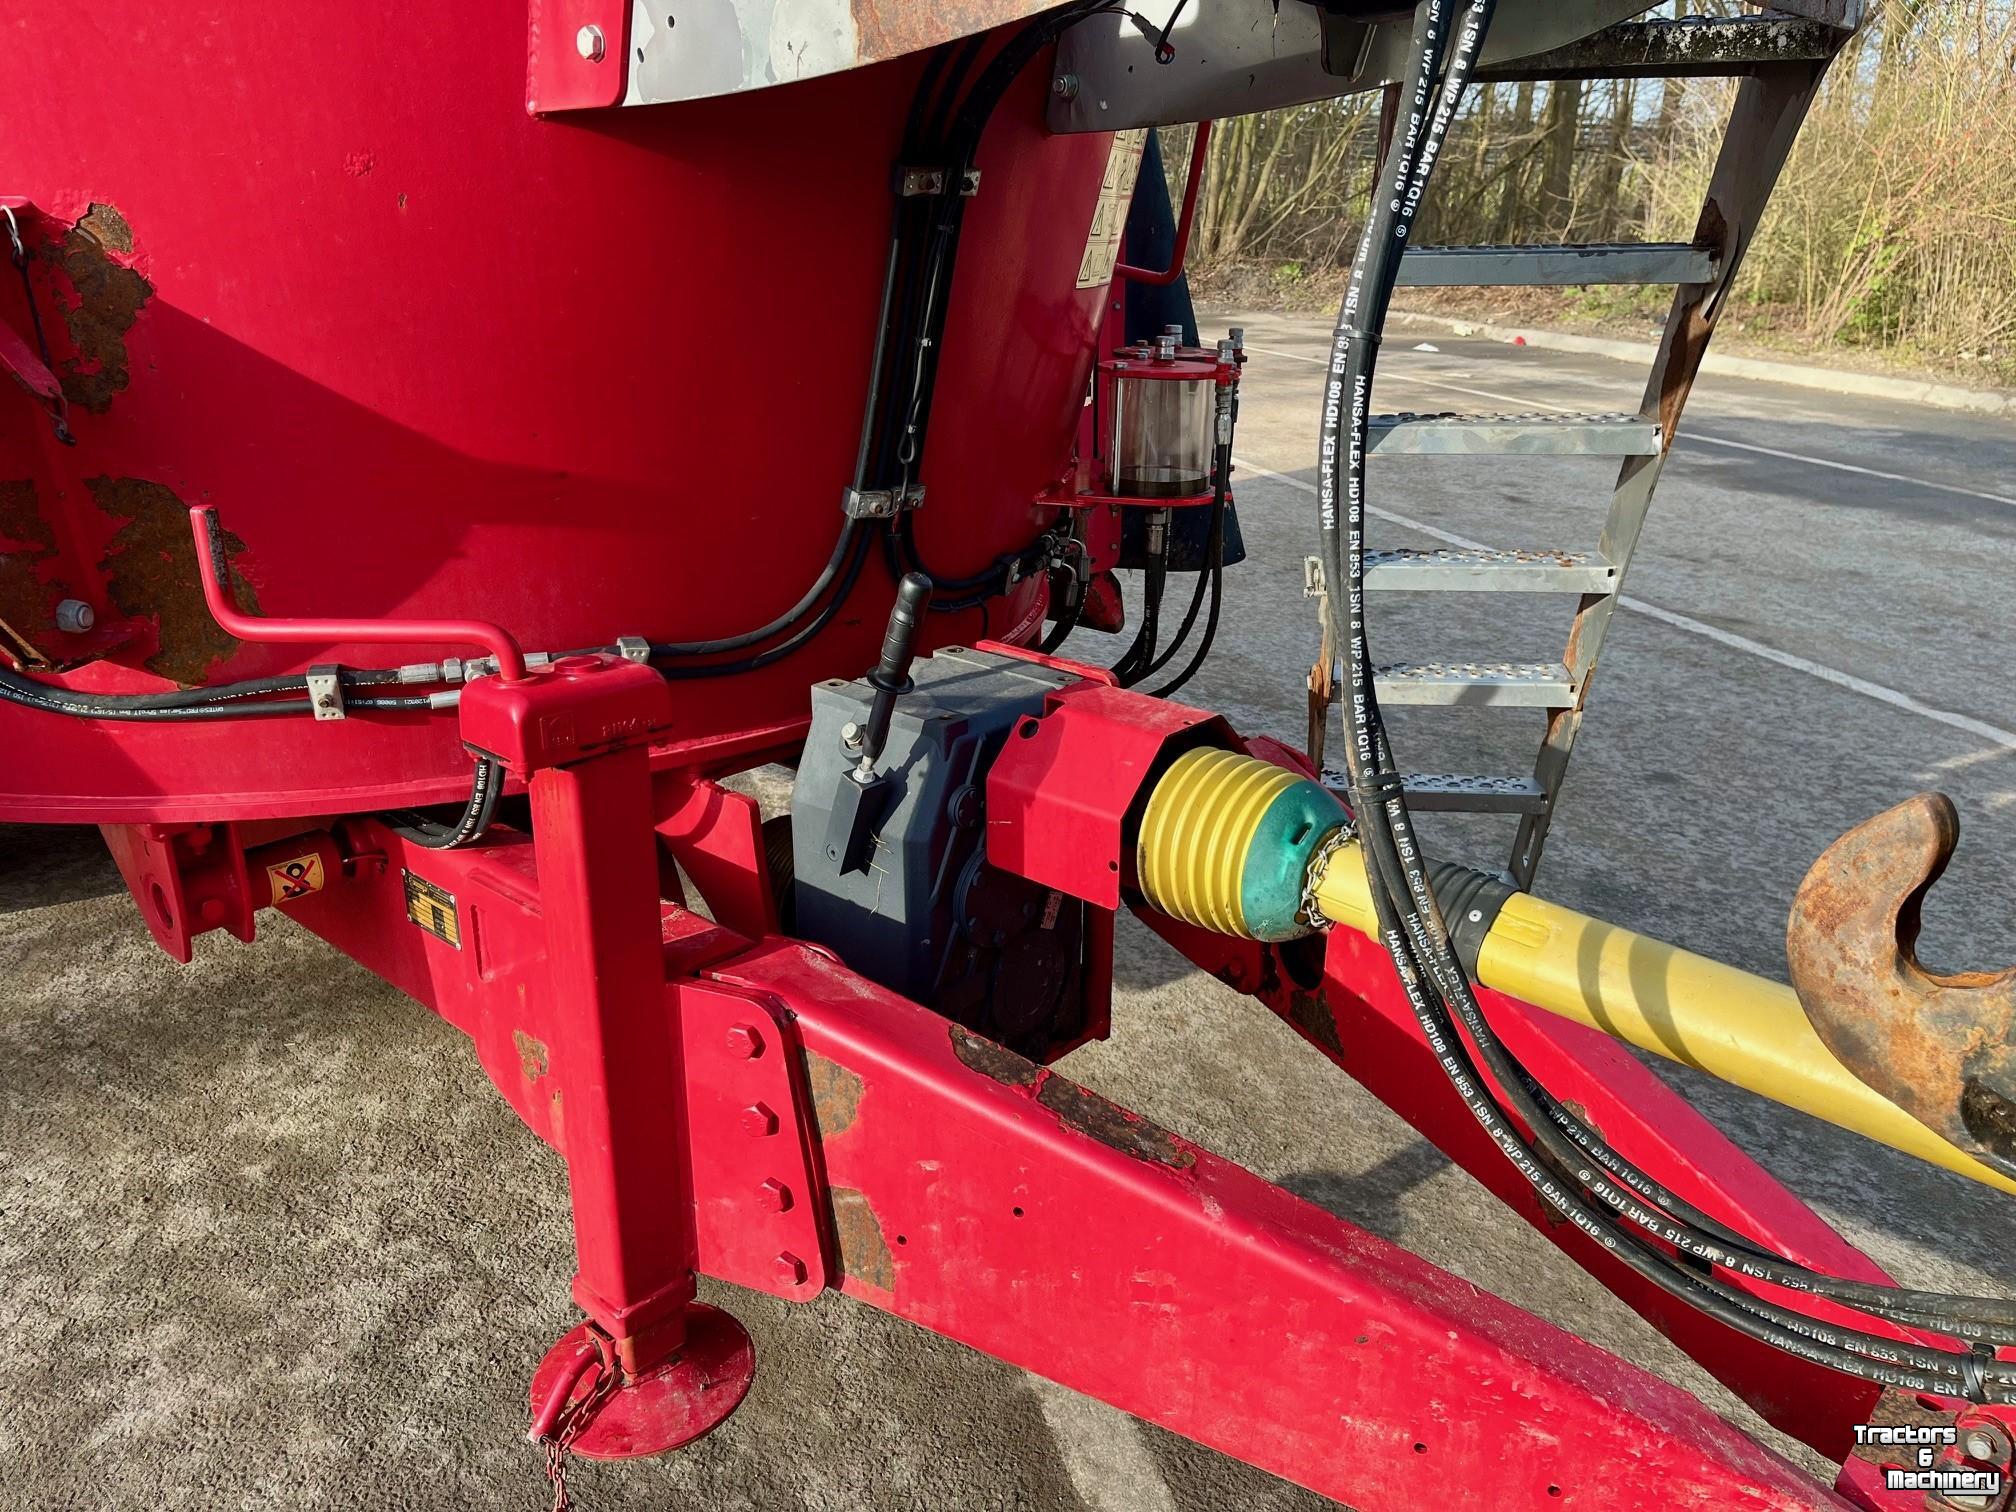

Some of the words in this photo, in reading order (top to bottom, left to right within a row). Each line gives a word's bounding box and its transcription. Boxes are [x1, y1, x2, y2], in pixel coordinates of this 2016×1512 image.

[1426, 29, 1437, 40] 8
[1461, 21, 1479, 54] 1SN
[1421, 49, 1434, 76] WP
[1454, 58, 1467, 71] 8
[1414, 77, 1428, 106] 215
[1444, 78, 1462, 105] WP
[1406, 112, 1420, 149] BAR
[1431, 105, 1451, 135] 215
[1415, 139, 1439, 176] BAR
[1394, 153, 1412, 191] 1Q16
[1401, 179, 1424, 217] 1Q16
[1344, 285, 1360, 315] 1SN
[1332, 352, 1347, 375] EN
[1324, 380, 1343, 428] HD108
[1349, 375, 1366, 470] HANSA-FLEX
[1321, 435, 1337, 530] HANSA-FLEX
[1348, 477, 1360, 523] HD108
[1349, 530, 1361, 550] EN
[1349, 554, 1361, 578] 853
[1349, 585, 1361, 614] 1SN
[1350, 620, 1362, 630] 8
[1350, 636, 1363, 660] WP
[1351, 663, 1364, 687] 215
[1353, 694, 1367, 724] BAR
[1356, 727, 1371, 761] 1Q16
[476, 764, 487, 790] HD108
[470, 803, 481, 816] 853
[474, 792, 484, 804] EN
[1393, 822, 1405, 832] 8
[1397, 837, 1416, 864] 1SN
[1409, 869, 1425, 893] 853
[1416, 895, 1431, 914] EN
[1386, 929, 1426, 1011] HANSA-FLEX
[1419, 1013, 1447, 1054] HD108
[1443, 1056, 1460, 1076] EN
[1454, 1074, 1474, 1098] 853
[1472, 1100, 1495, 1126] 1SN
[1493, 1127, 1503, 1138] 8
[1503, 1138, 1523, 1159] WP
[1519, 1159, 1544, 1181] 215
[1541, 1182, 1570, 1211] BAR
[1569, 1207, 1601, 1237] 1Q16
[1566, 1124, 1590, 1146] 215
[1590, 1146, 1621, 1172] BAR
[1621, 1167, 1653, 1195] 1Q16
[1593, 1182, 1627, 1210] 1Q16
[1627, 1206, 1660, 1232] BAR
[1664, 1228, 1692, 1249] 215
[1692, 1243, 1718, 1264] WP
[1724, 1256, 1736, 1268] 8
[1741, 1263, 1773, 1280] 1SN
[1787, 1320, 1836, 1346] HD108
[1844, 1337, 1867, 1355] EN
[1870, 1345, 1898, 1362] 853
[1903, 1351, 1939, 1372] 1SN
[1872, 1367, 1925, 1390] HD108
[1933, 1381, 1958, 1396] EN
